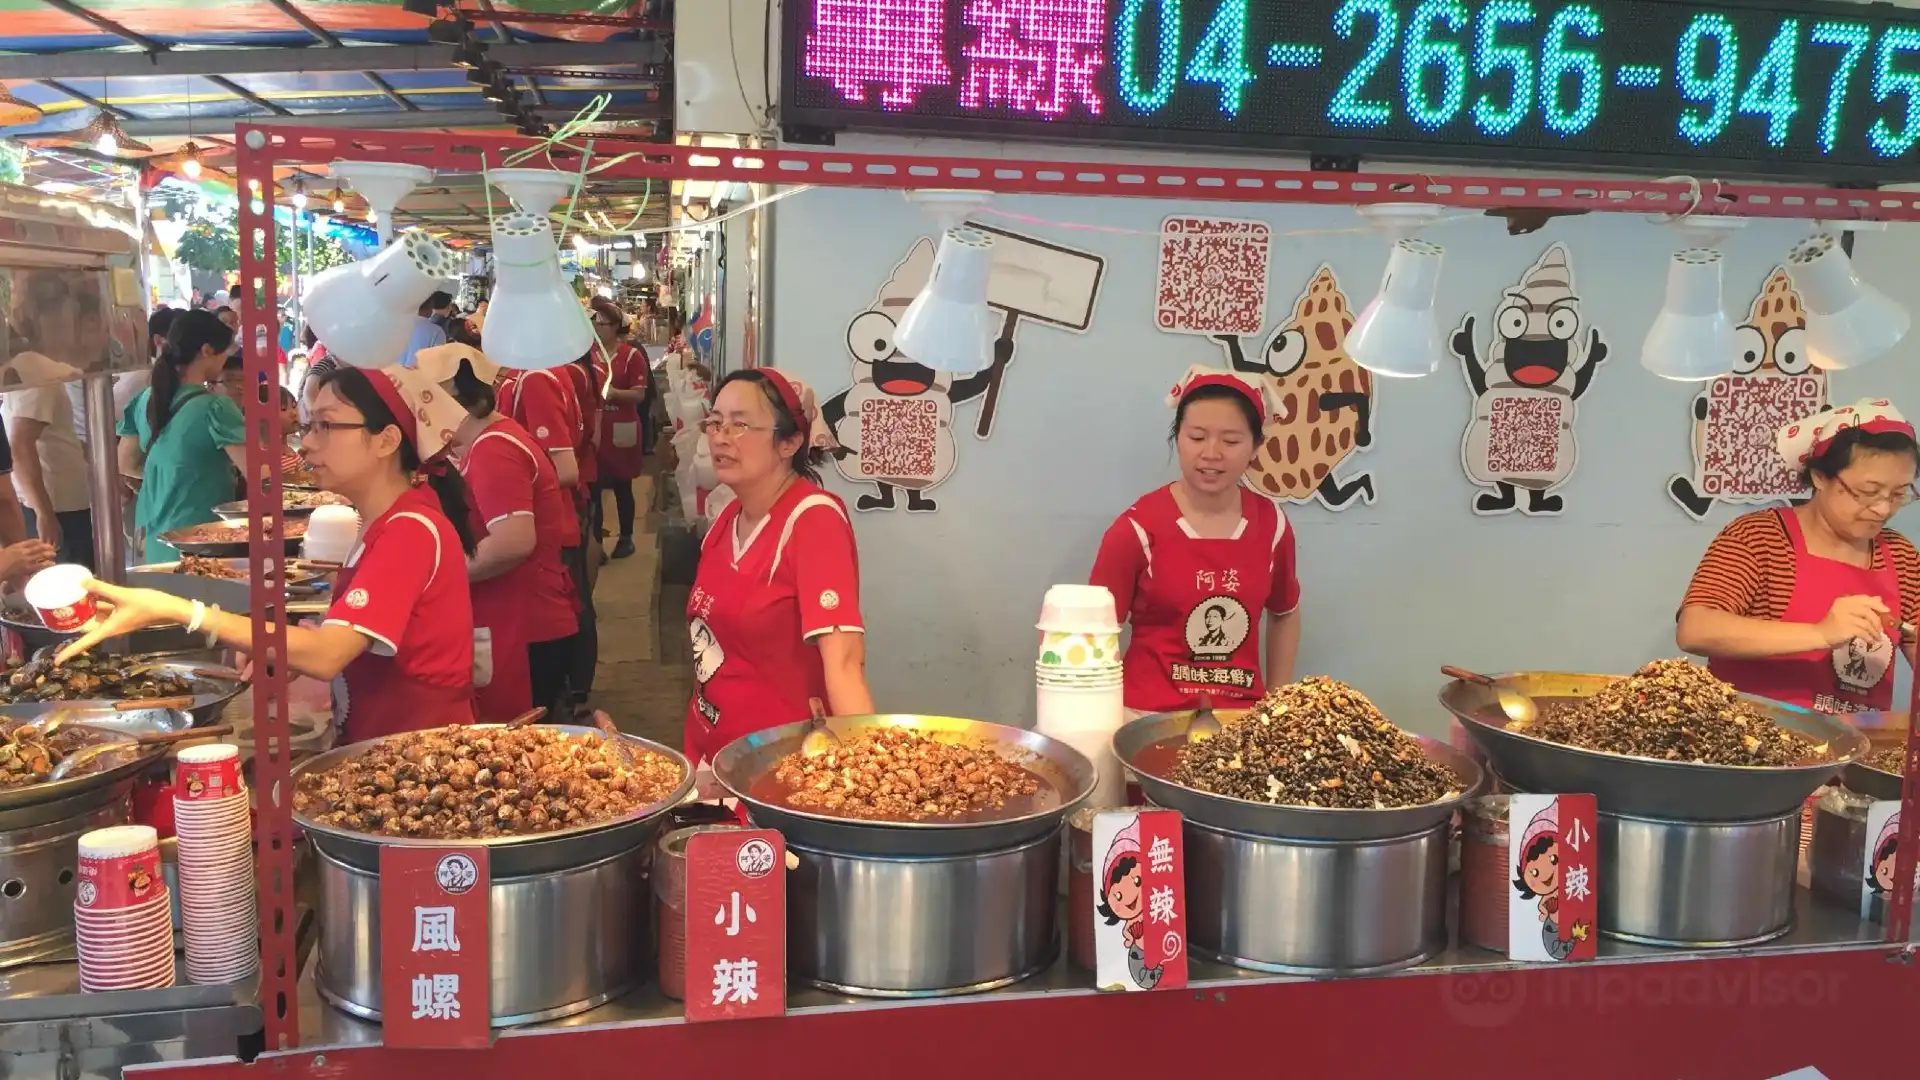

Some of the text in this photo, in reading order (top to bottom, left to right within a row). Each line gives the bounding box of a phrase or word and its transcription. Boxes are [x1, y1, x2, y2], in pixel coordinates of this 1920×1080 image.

[1111, 0, 1920, 158] 04-2656-9475
[1196, 568, 1241, 593] 阿姿
[1171, 664, 1246, 686] 調味海鮮
[1148, 834, 1179, 926] 無辣
[1565, 818, 1592, 902] 小辣
[411, 905, 461, 1020] 風螺
[711, 891, 759, 1006] 小辣
